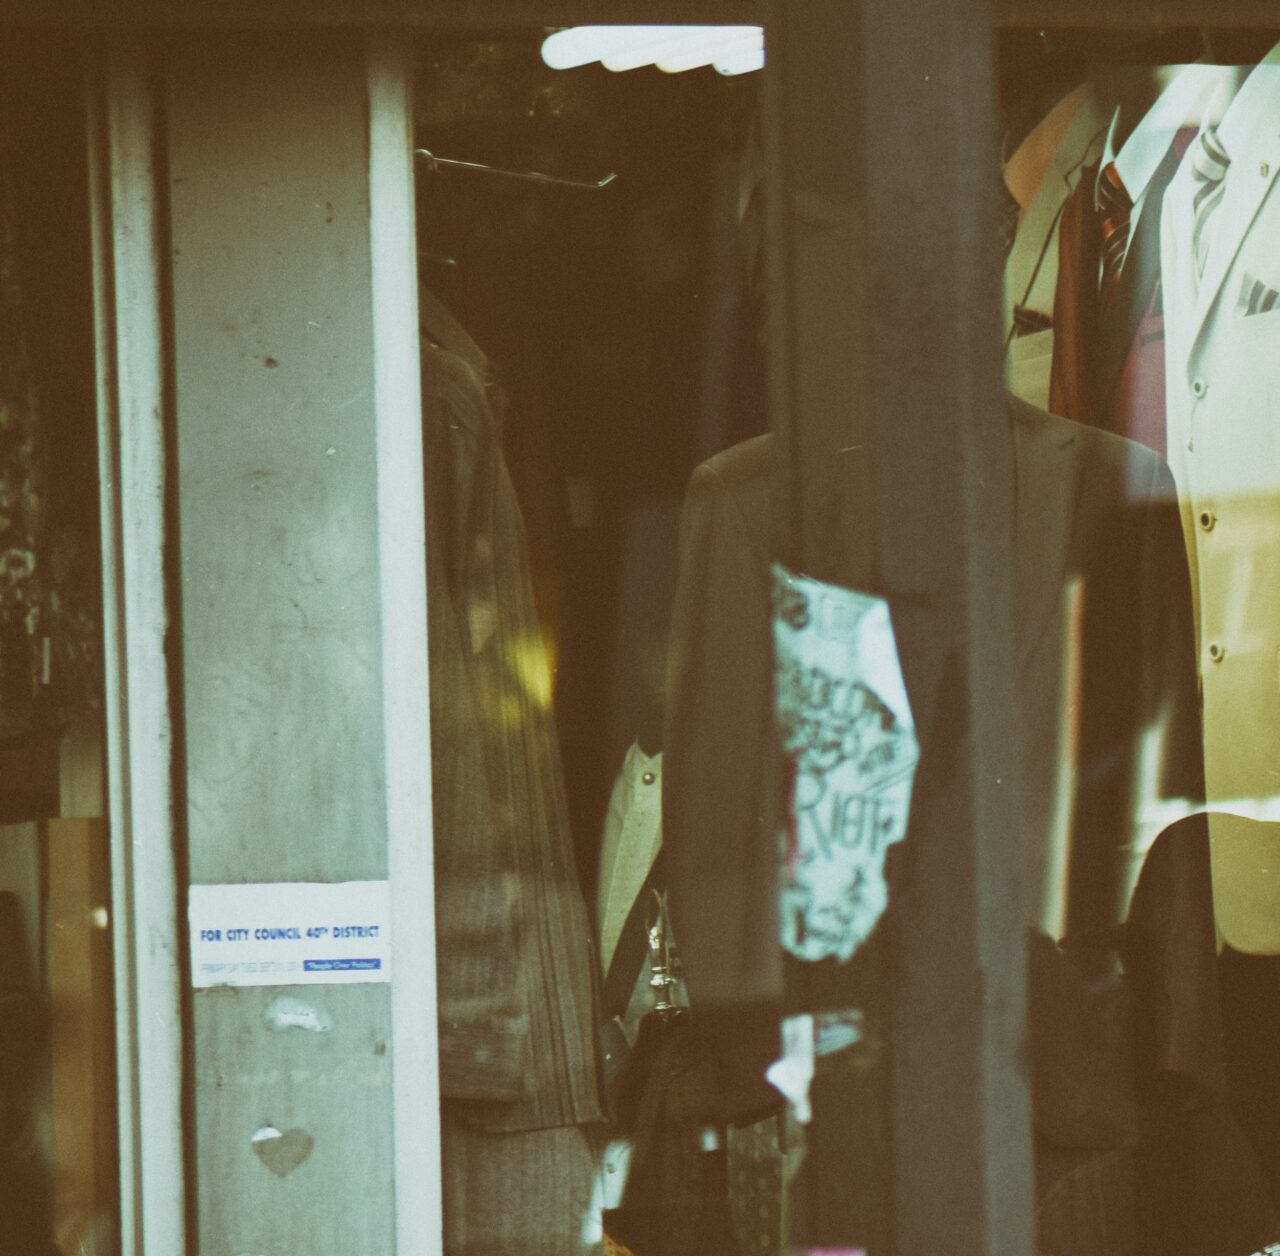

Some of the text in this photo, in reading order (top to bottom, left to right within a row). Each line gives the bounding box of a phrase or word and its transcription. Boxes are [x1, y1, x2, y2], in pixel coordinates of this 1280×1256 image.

[200, 929, 222, 942] FOR
[226, 928, 250, 941] CITY
[254, 927, 302, 940] COUNCIL
[332, 925, 380, 939] DISTRICT
